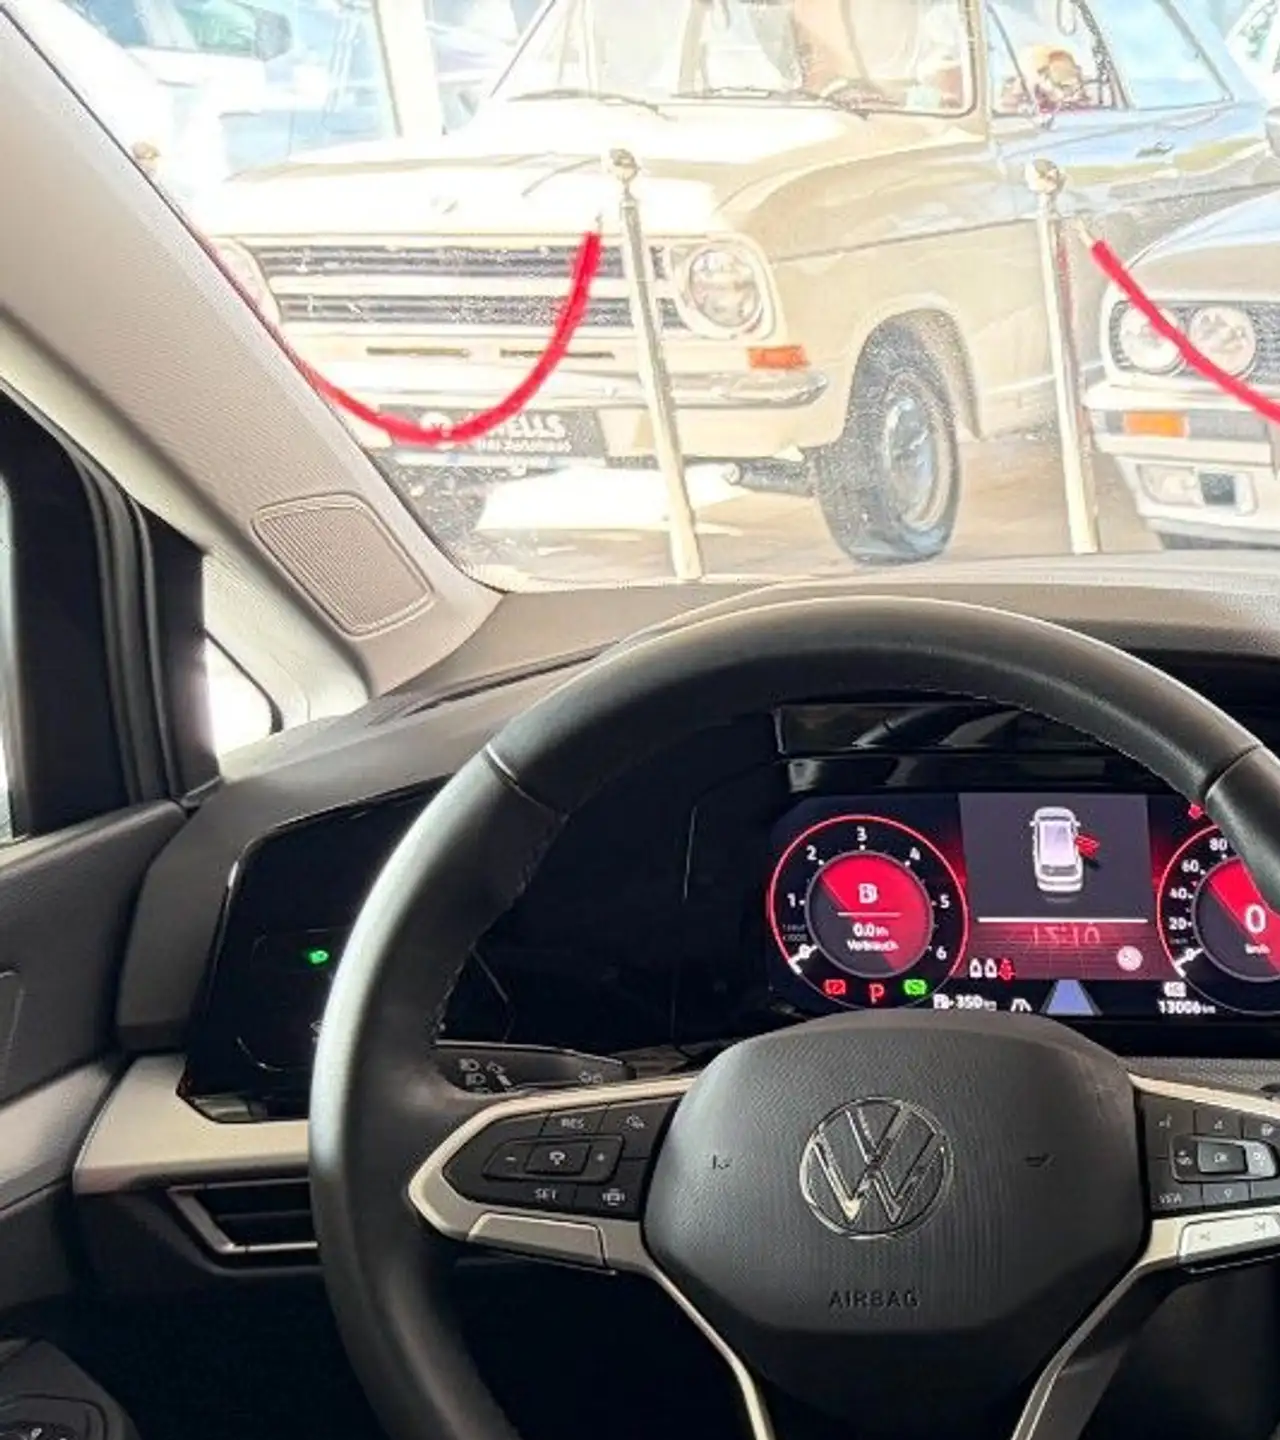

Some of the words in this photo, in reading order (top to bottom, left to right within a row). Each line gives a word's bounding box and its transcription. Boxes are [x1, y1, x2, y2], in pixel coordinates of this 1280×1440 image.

[856, 826, 868, 842] 3
[1209, 838, 1228, 851] 80
[806, 845, 818, 861] 2
[909, 847, 922, 861] 4
[1181, 859, 1199, 873] 60
[787, 893, 797, 908] 1
[1169, 887, 1187, 900] 40
[940, 895, 950, 908] 5
[1168, 917, 1187, 931] 20
[1244, 904, 1267, 934] 0
[936, 946, 947, 960] 6
[956, 995, 982, 1010] 350
[1158, 1001, 1200, 1014] 13006
[561, 1117, 585, 1129] RES
[535, 1187, 557, 1200] SET
[827, 1289, 920, 1309] AIRBAG
